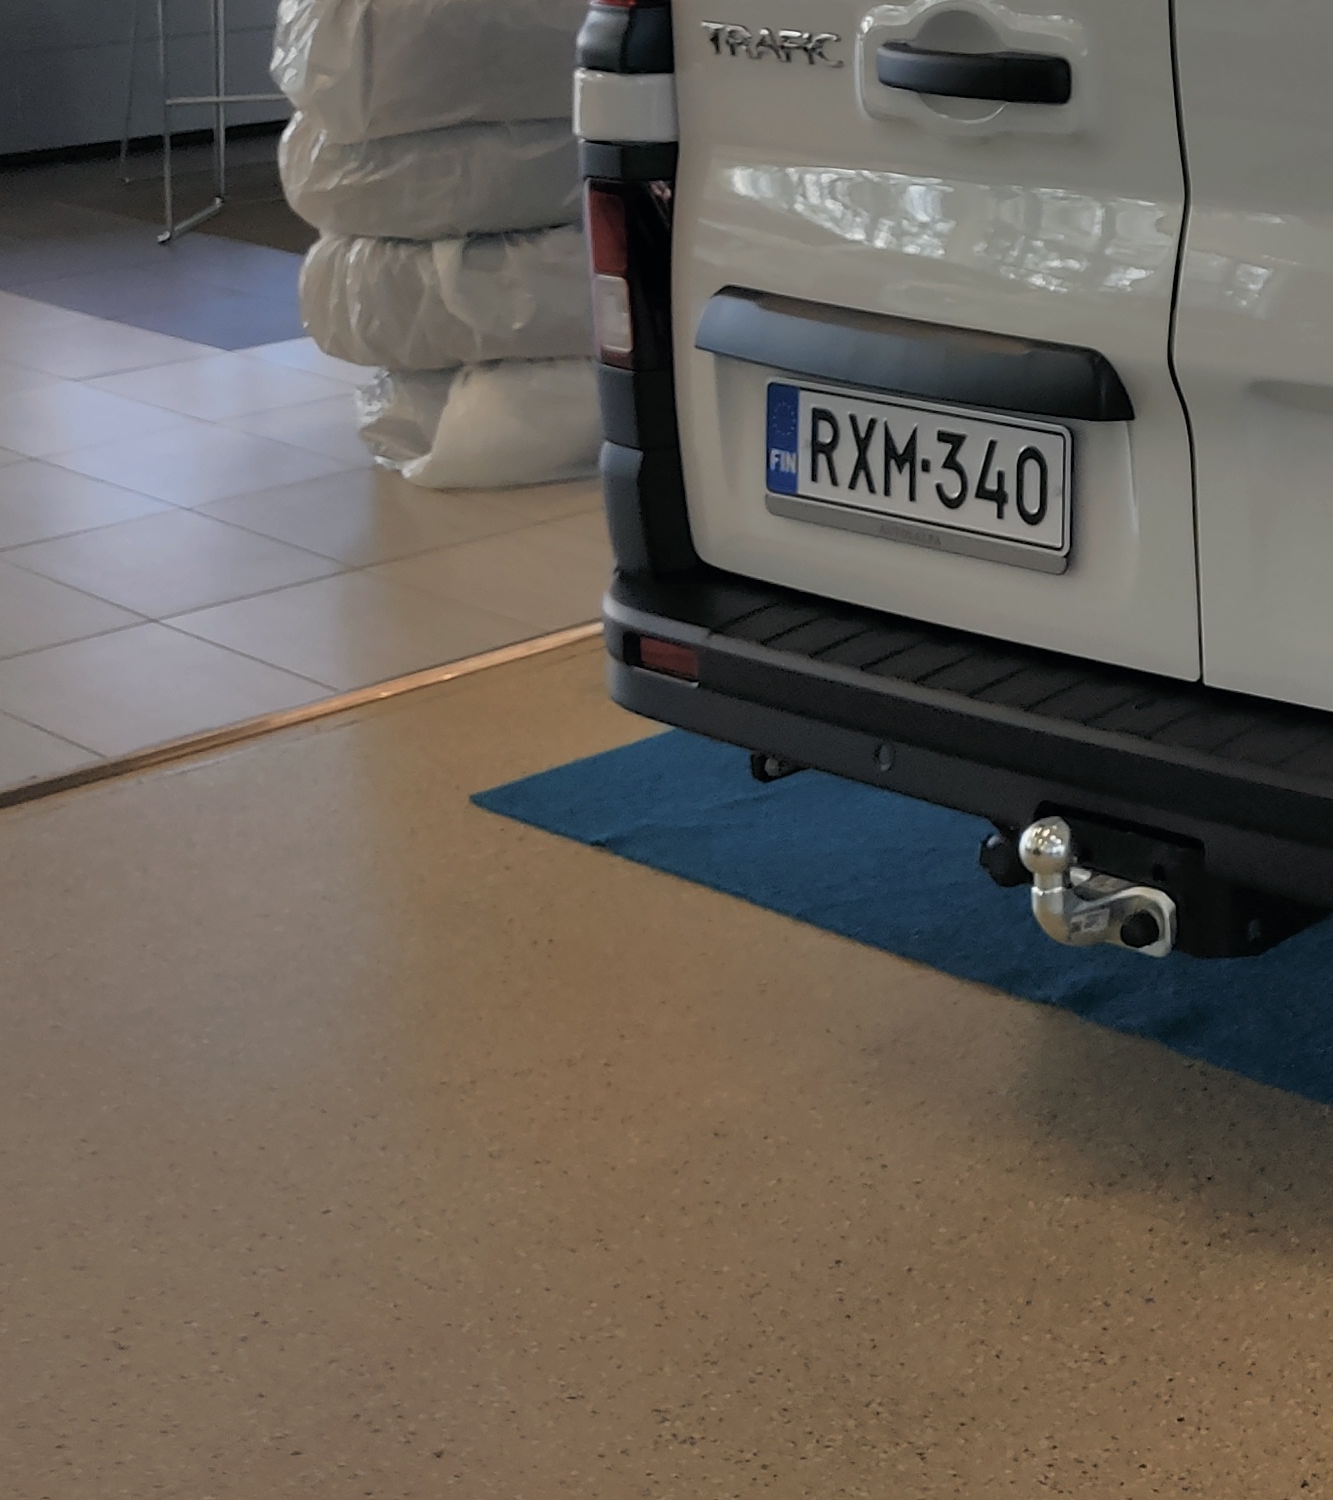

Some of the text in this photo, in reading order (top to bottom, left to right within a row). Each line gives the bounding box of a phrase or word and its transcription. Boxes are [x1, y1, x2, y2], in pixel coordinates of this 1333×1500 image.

[701, 20, 843, 68] TRAFIC
[770, 448, 797, 474] FIN
[811, 406, 1048, 526] RXM-340
